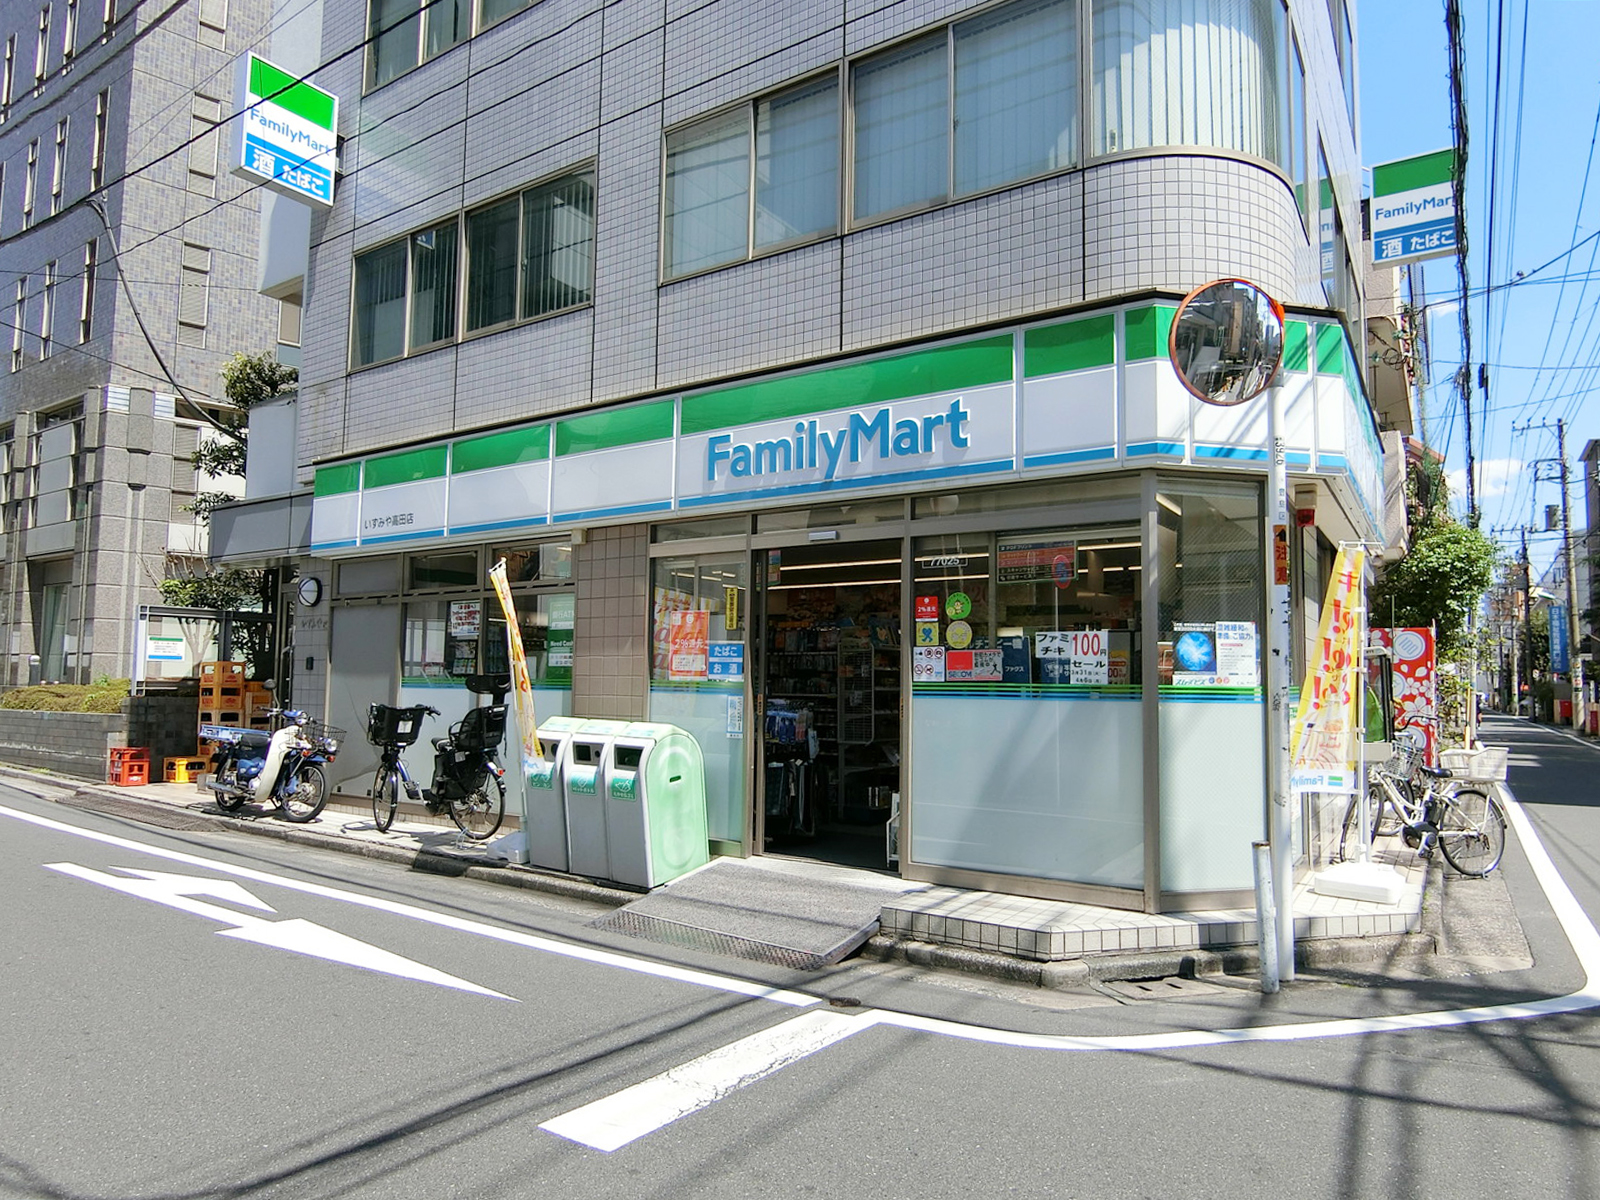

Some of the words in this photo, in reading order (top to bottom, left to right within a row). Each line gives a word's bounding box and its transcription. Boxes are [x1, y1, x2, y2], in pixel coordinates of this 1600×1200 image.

[250, 107, 331, 156] FamilyMart
[252, 148, 275, 176] 酒
[281, 164, 324, 195] たばこ
[1375, 195, 1456, 220] FamilyMar
[1381, 237, 1402, 257] 酒
[1410, 229, 1455, 251] たばこ
[707, 397, 969, 481] FamilyMart
[713, 646, 738, 656] たばこ
[1036, 633, 1069, 643] ファミ
[1041, 646, 1065, 656] チキ
